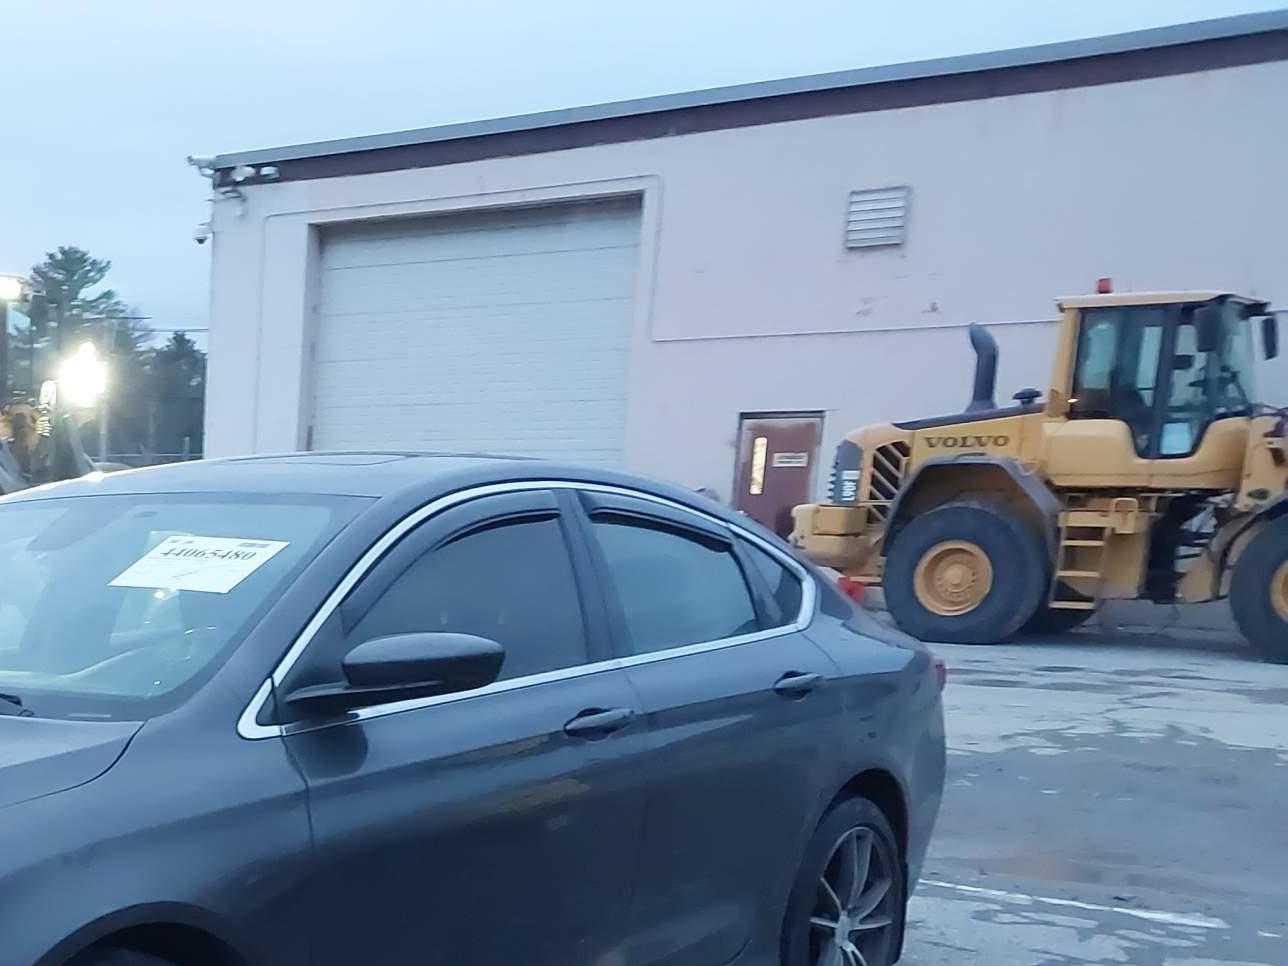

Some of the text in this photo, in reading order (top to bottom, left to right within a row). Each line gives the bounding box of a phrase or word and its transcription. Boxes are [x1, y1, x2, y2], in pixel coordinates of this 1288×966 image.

[924, 435, 1009, 448] VOLVO
[842, 480, 856, 501] L90F
[160, 547, 257, 560] 44065480
